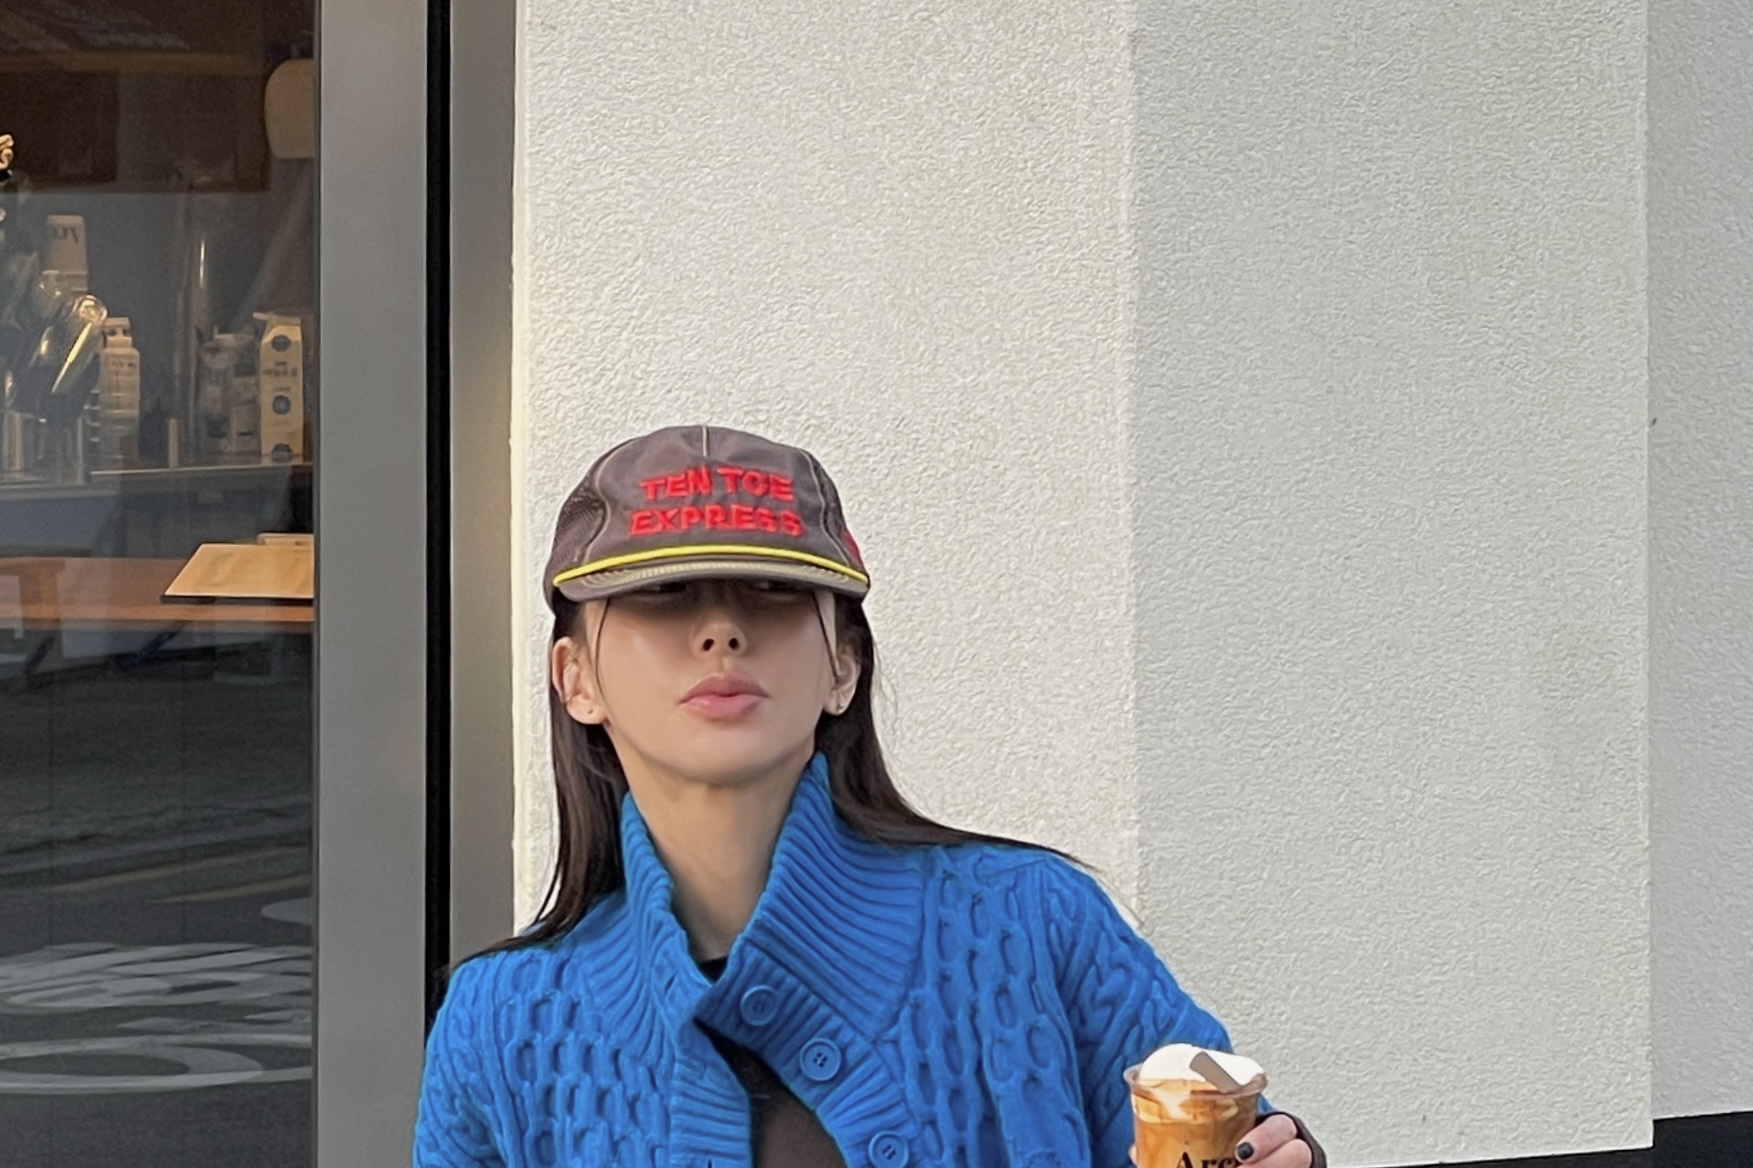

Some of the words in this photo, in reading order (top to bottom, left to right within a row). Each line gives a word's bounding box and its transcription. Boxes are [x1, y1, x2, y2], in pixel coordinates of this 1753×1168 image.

[639, 465, 713, 501] TEN
[716, 465, 795, 503] TOE
[628, 502, 805, 538] EXPRESS
